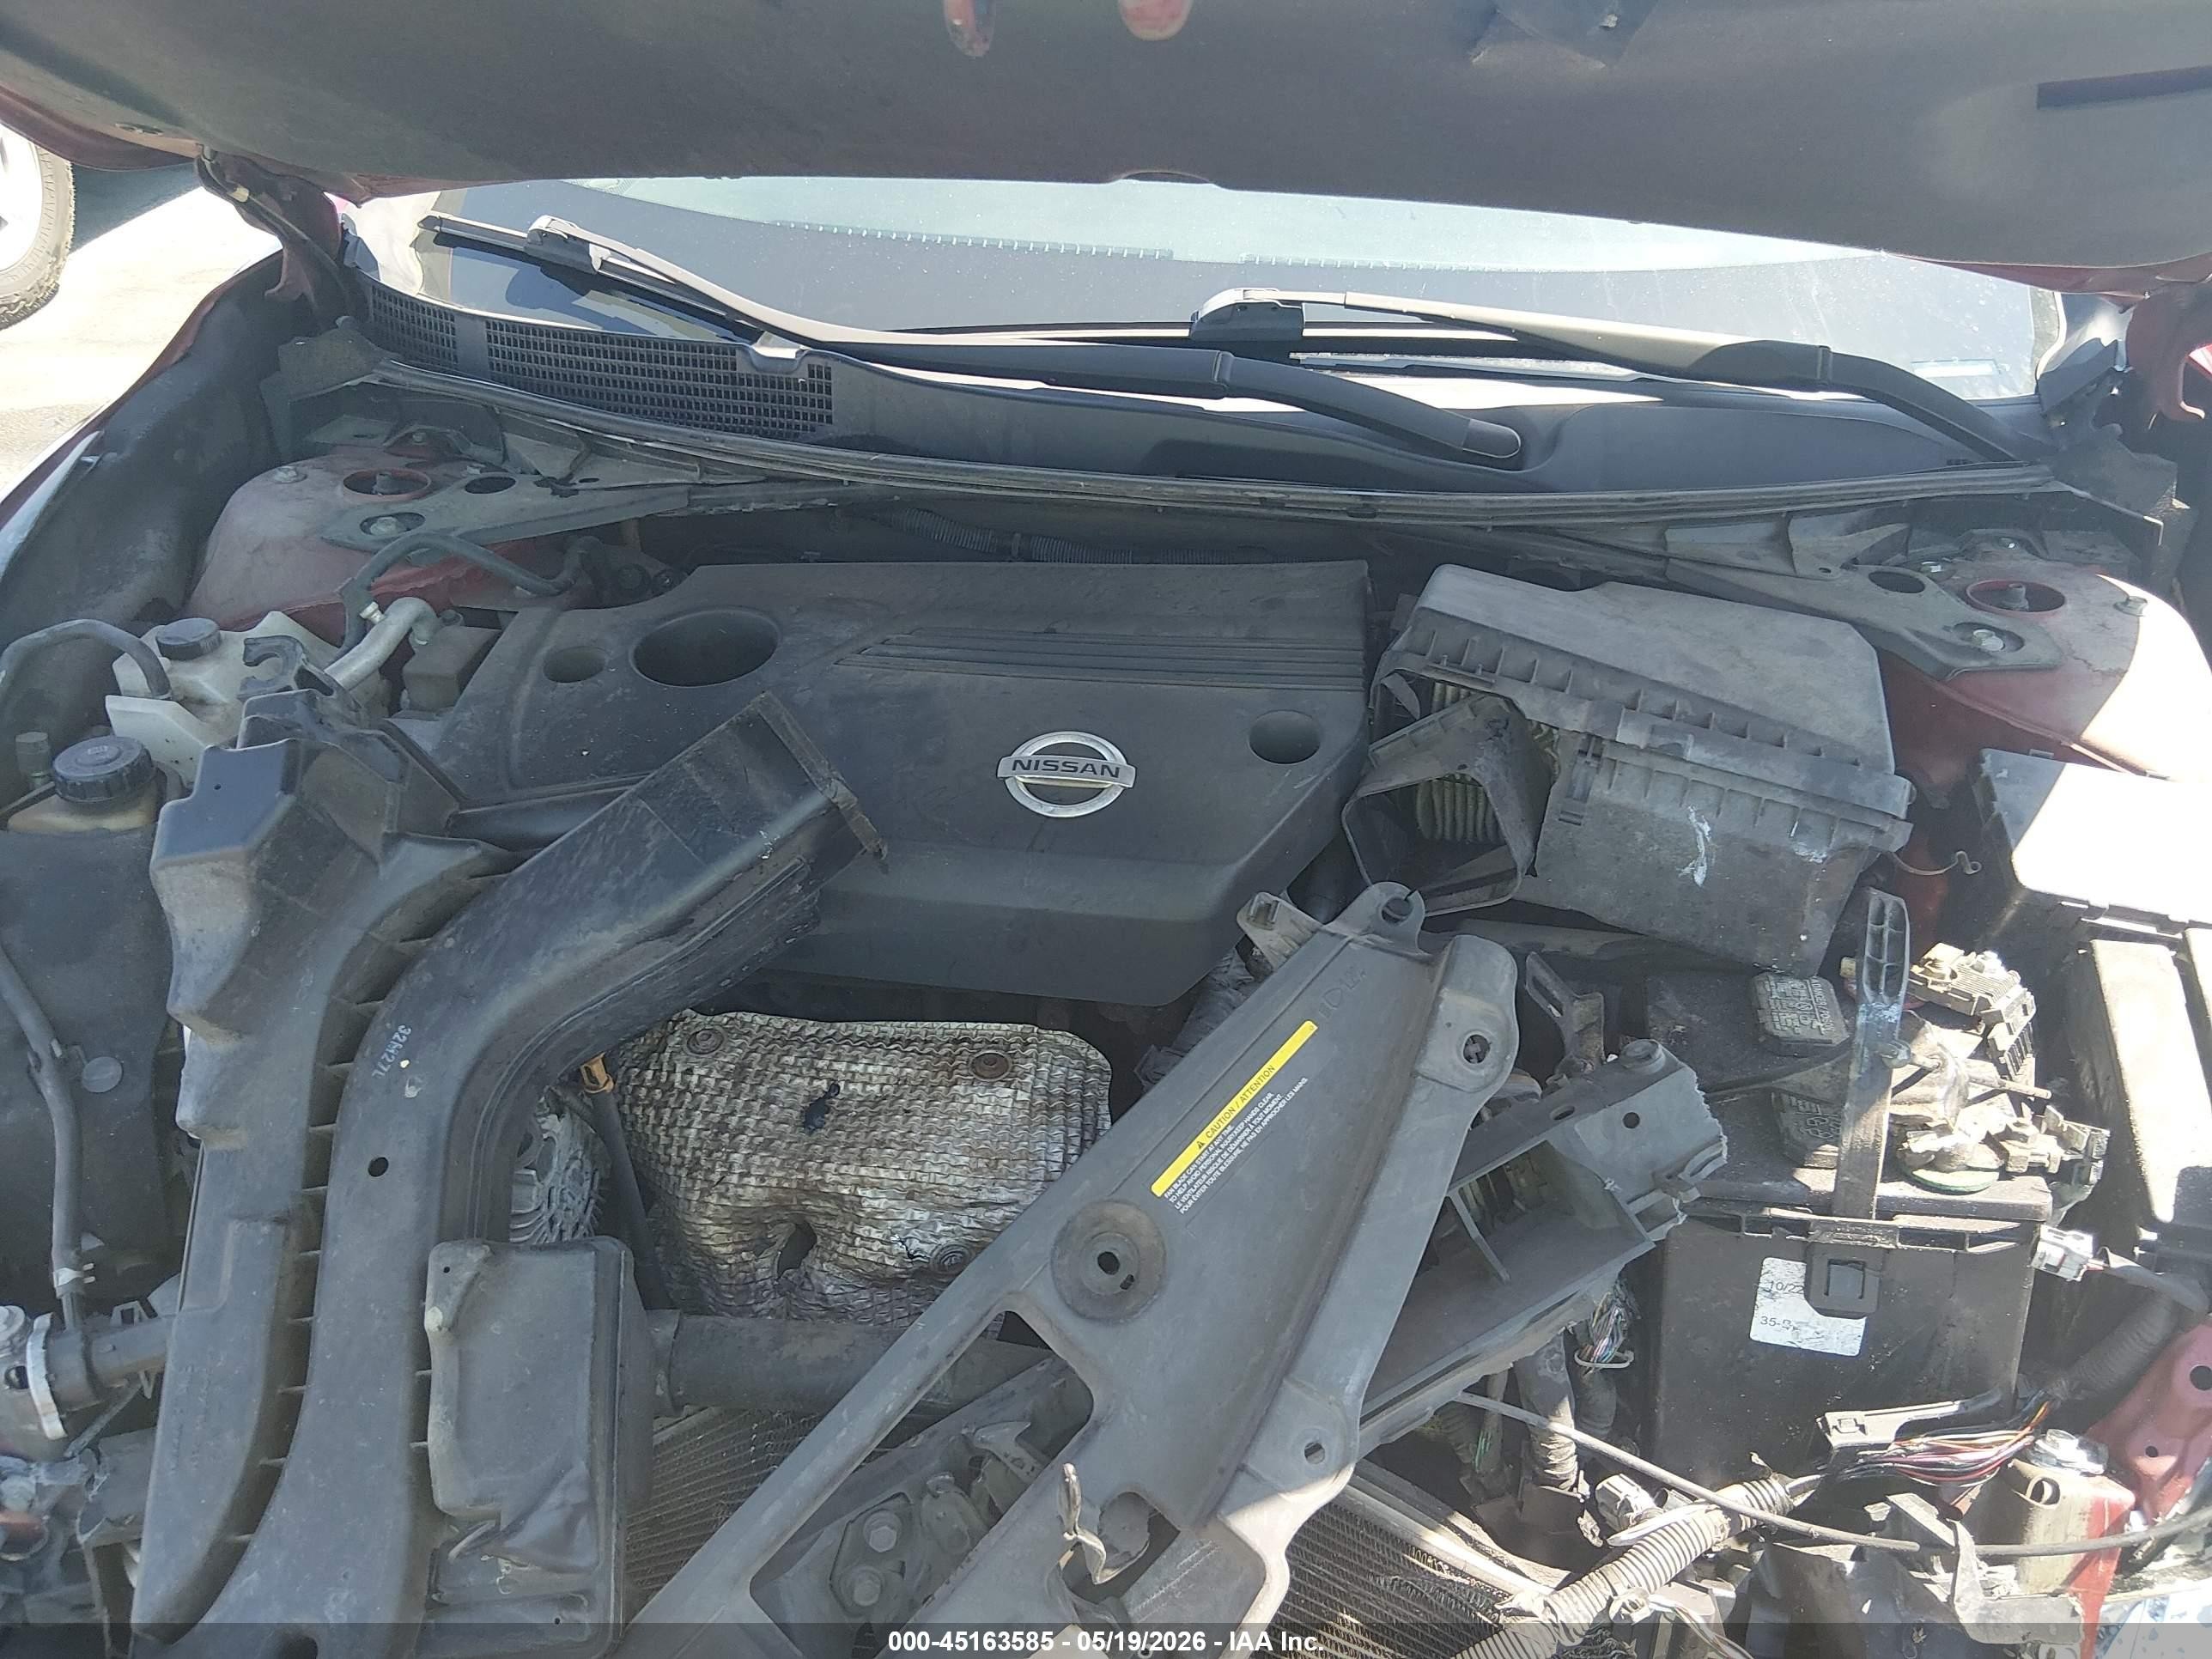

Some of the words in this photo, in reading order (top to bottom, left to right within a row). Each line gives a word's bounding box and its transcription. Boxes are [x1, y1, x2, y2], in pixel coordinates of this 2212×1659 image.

[1012, 759, 1120, 779] NISSAN
[1205, 1106, 1237, 1139] CAUTION
[1238, 1064, 1275, 1103] ATTENTION
[1164, 1187, 1175, 1199] FAN
[1172, 1173, 1188, 1189] BLADE
[1185, 1163, 1197, 1175] CAN
[1194, 1149, 1210, 1165] START
[1212, 1133, 1224, 1146] ANY
[1169, 1194, 1177, 1203] TO
[1175, 1182, 1188, 1197] HELP
[1185, 1169, 1200, 1185] AVOID
[1198, 1146, 1222, 1171] PERSONAL
[1243, 1105, 1260, 1124] HANDS
[1174, 1200, 1182, 1209] LE
[1180, 1173, 1208, 1203] VENTILATEUR
[1205, 1157, 1223, 1176] RISQUE
[1220, 1150, 1230, 1159] DE
[1225, 1126, 1251, 1152] DÉMARRER
[1251, 1111, 1265, 1126] TOUT
[1179, 1198, 1194, 1214] POUR
[1190, 1182, 1208, 1201] ÉVITER
[1205, 1170, 1221, 1187] TOUTE
[1239, 1139, 1249, 1149] NE
[1245, 1131, 1257, 1142] PAS
[1254, 1124, 1263, 1133] EN
[1260, 1098, 1287, 1127] APPROCHER
[1284, 1090, 1295, 1101] LES
